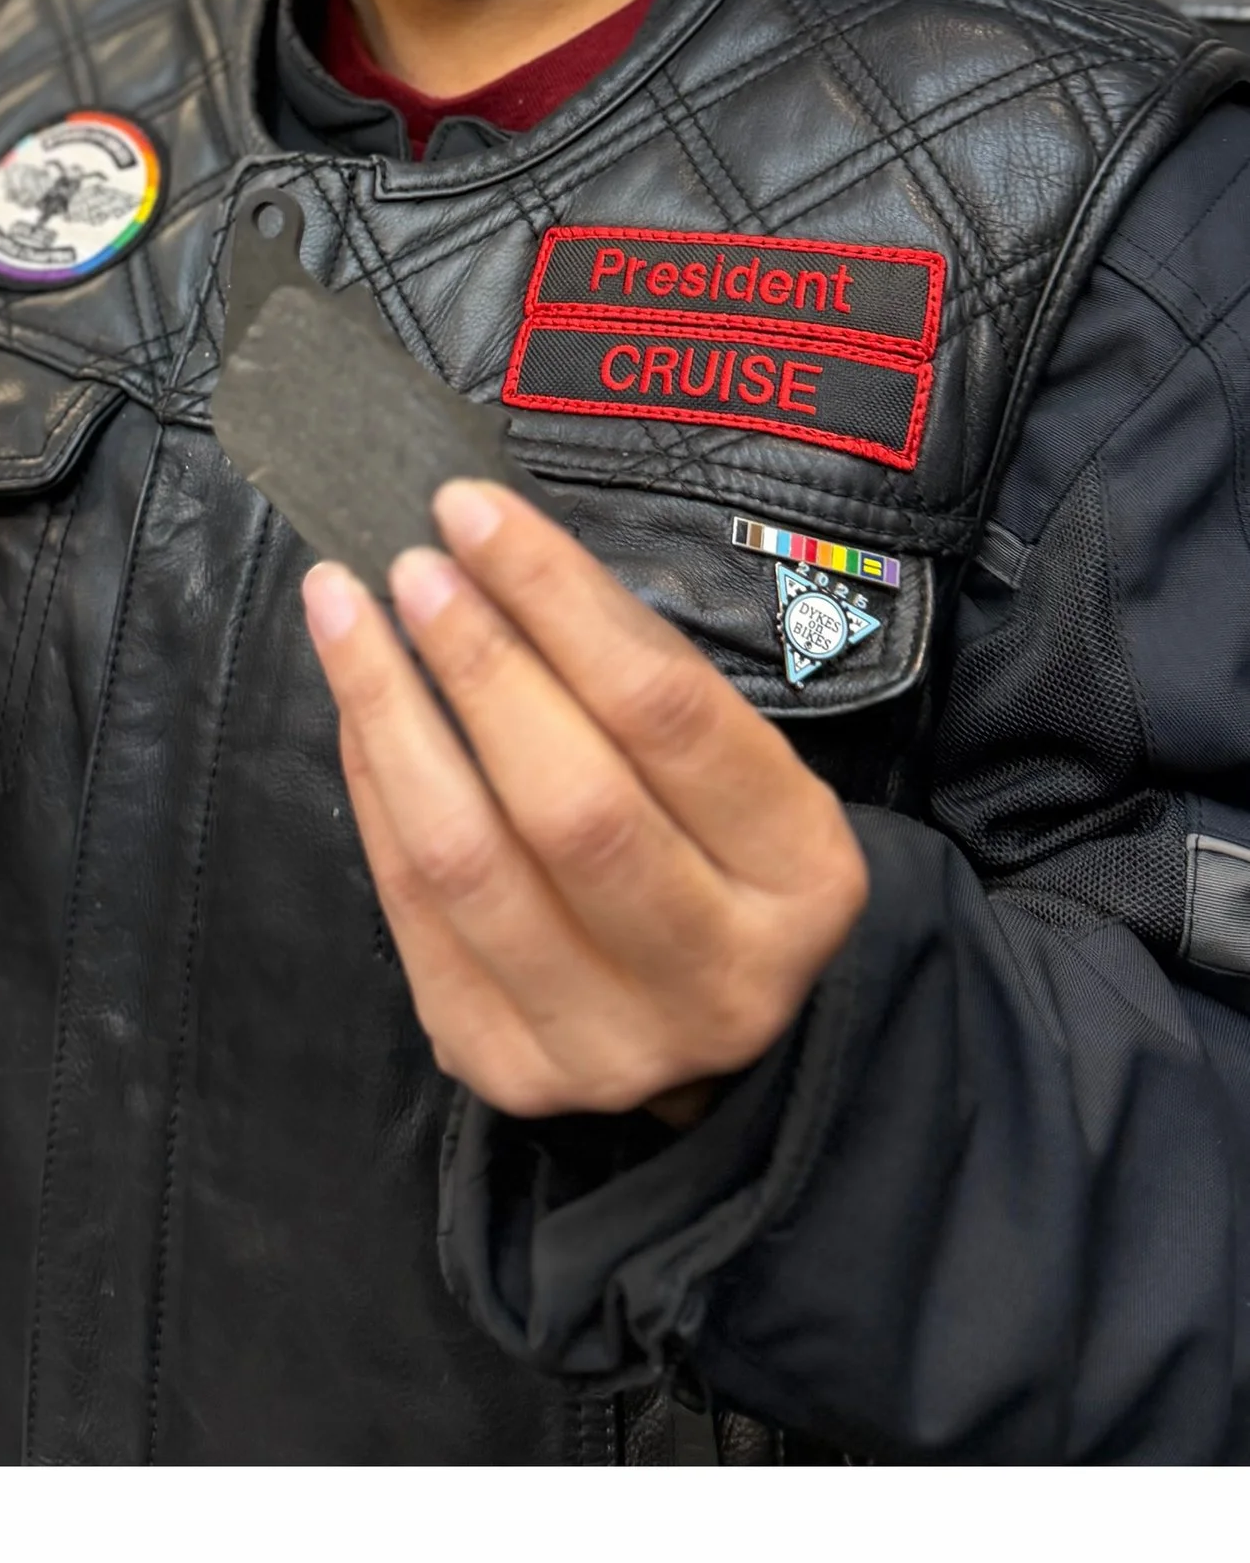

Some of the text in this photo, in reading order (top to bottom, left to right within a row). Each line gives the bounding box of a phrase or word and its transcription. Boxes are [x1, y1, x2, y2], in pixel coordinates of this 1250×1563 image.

[590, 247, 854, 313] President
[601, 344, 823, 415] CRUISE
[796, 561, 868, 609] 2025
[793, 622, 832, 651] BIKES
[799, 602, 841, 634] DYKES
[808, 620, 824, 634] on
